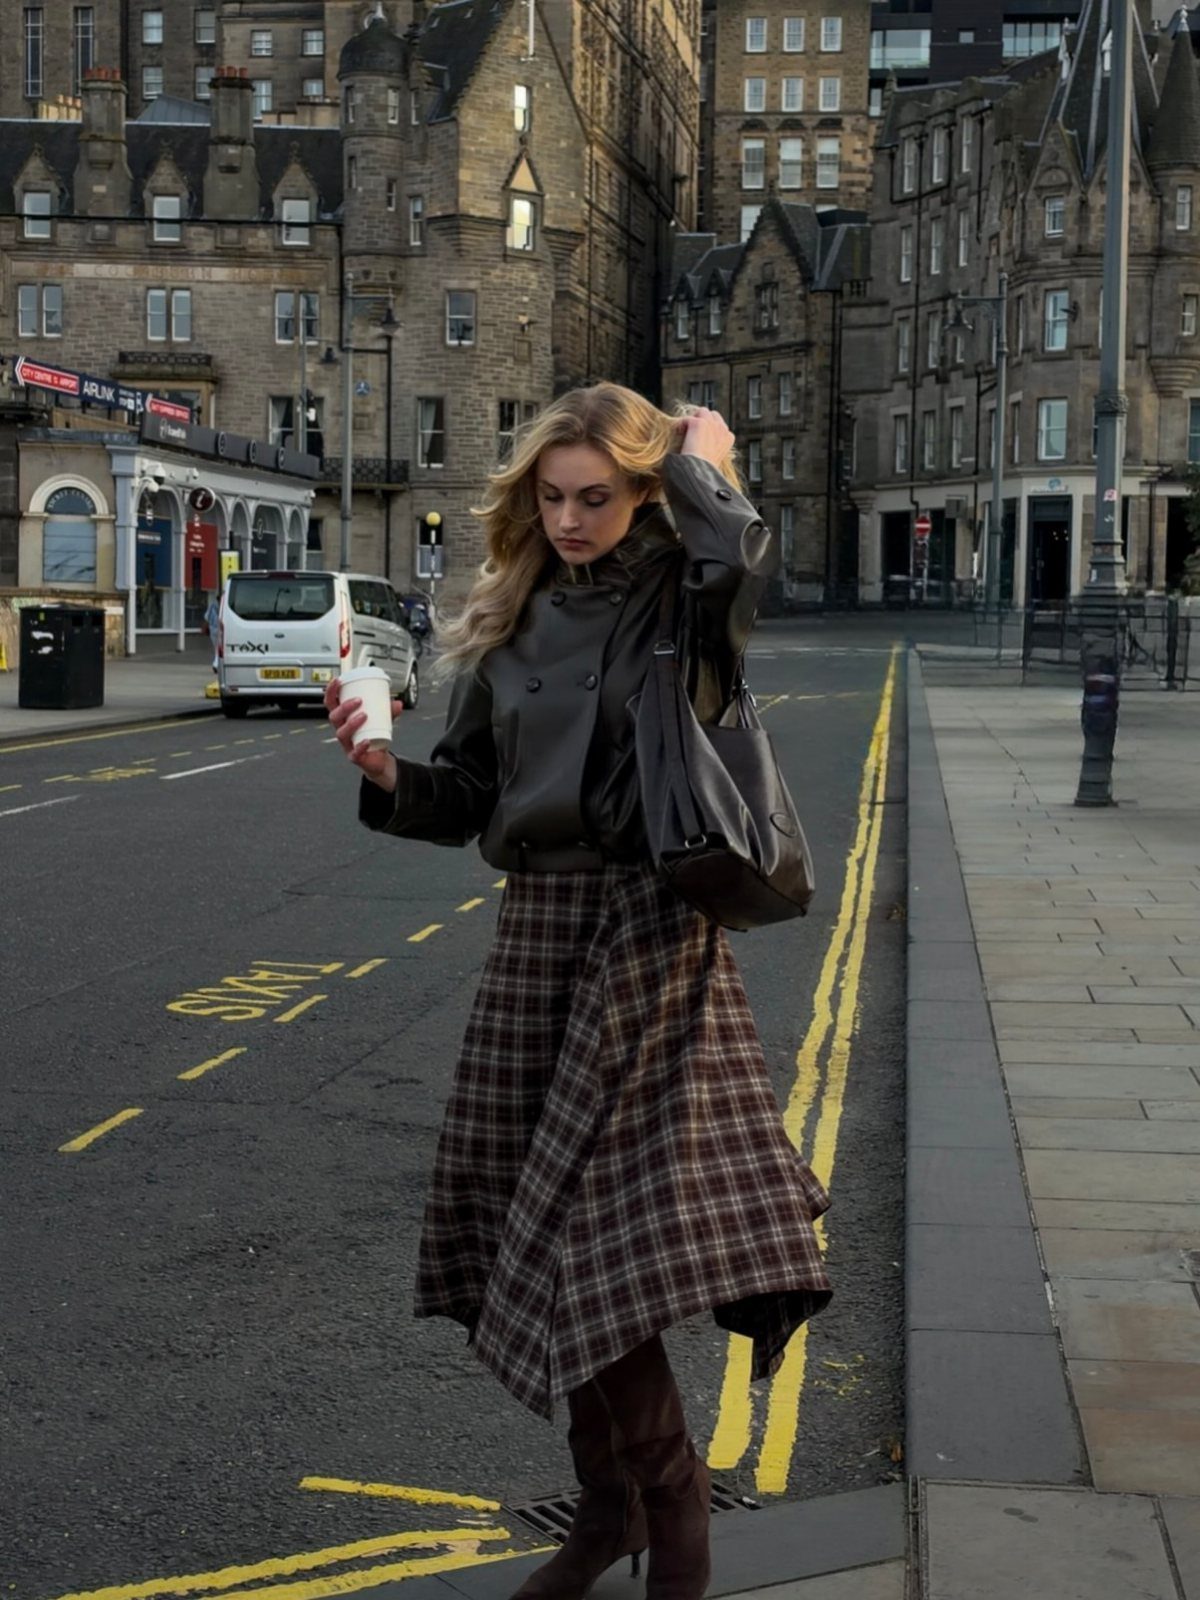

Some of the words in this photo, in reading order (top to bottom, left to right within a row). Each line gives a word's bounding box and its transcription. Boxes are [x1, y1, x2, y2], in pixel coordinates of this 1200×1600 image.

[83, 380, 116, 403] AIRLINK
[225, 640, 269, 655] TAXI
[165, 961, 345, 1021] TAXIS
